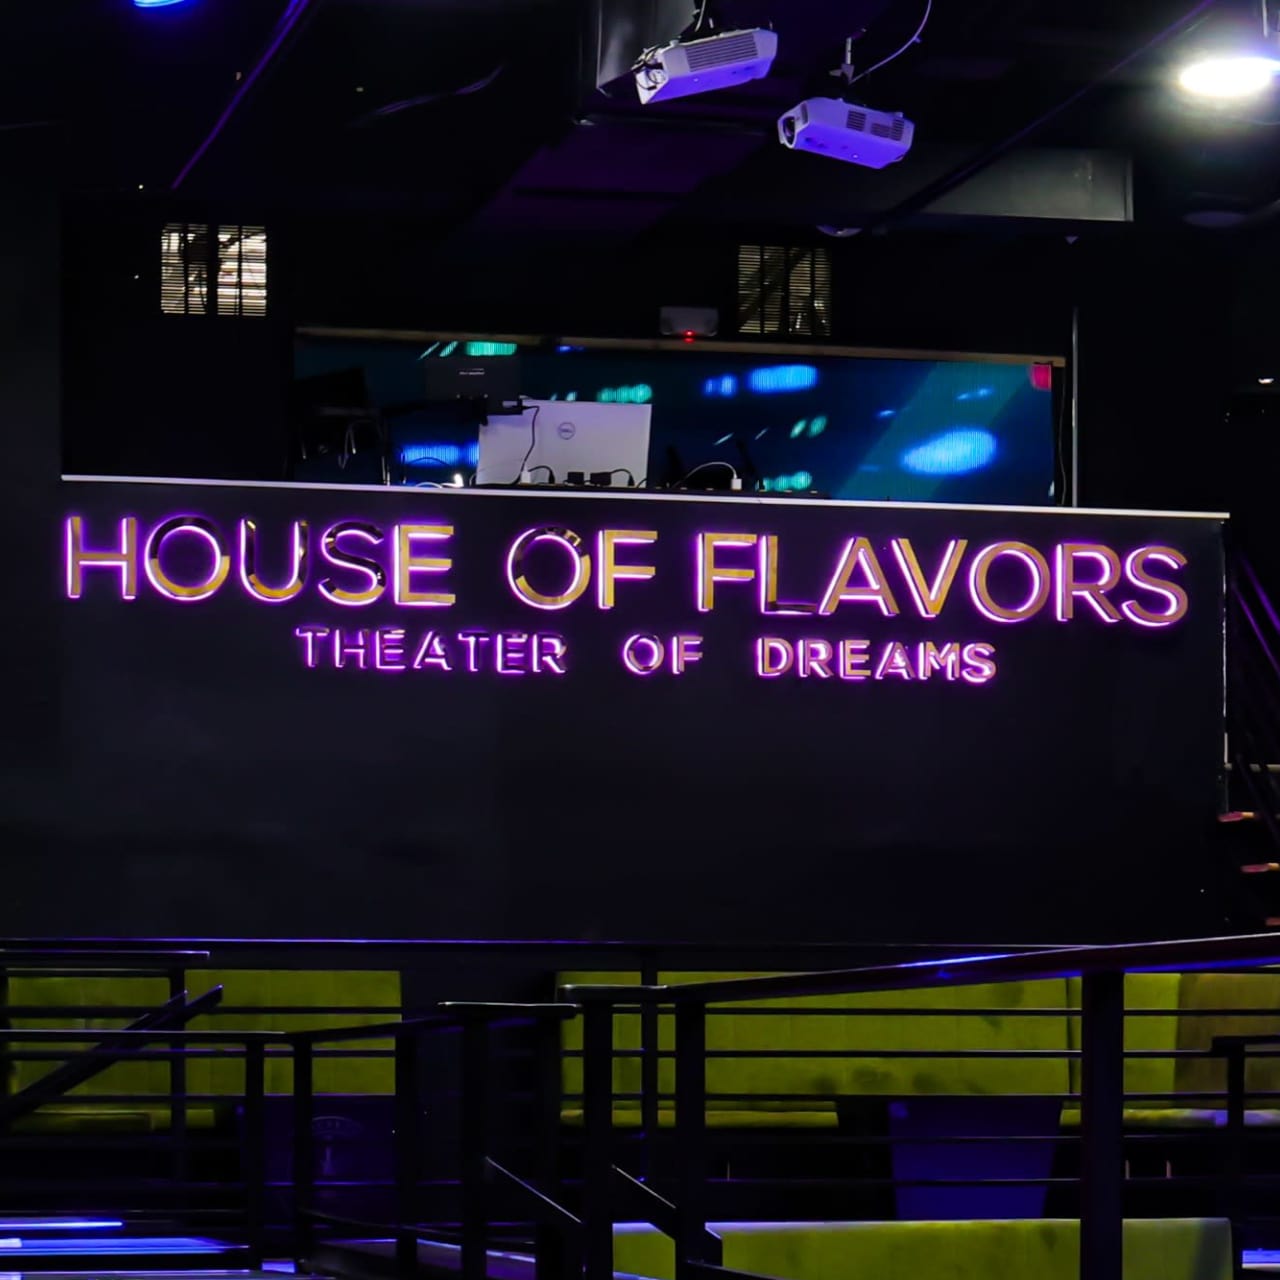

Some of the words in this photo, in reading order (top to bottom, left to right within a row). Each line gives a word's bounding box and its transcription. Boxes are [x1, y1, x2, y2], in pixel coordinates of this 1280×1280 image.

[66, 514, 457, 606] HOUSE
[507, 527, 659, 611] OF
[697, 532, 1189, 627] FLAVORS
[295, 627, 568, 675] THEATER
[622, 633, 705, 676] OF
[756, 637, 998, 683] DREAMS
